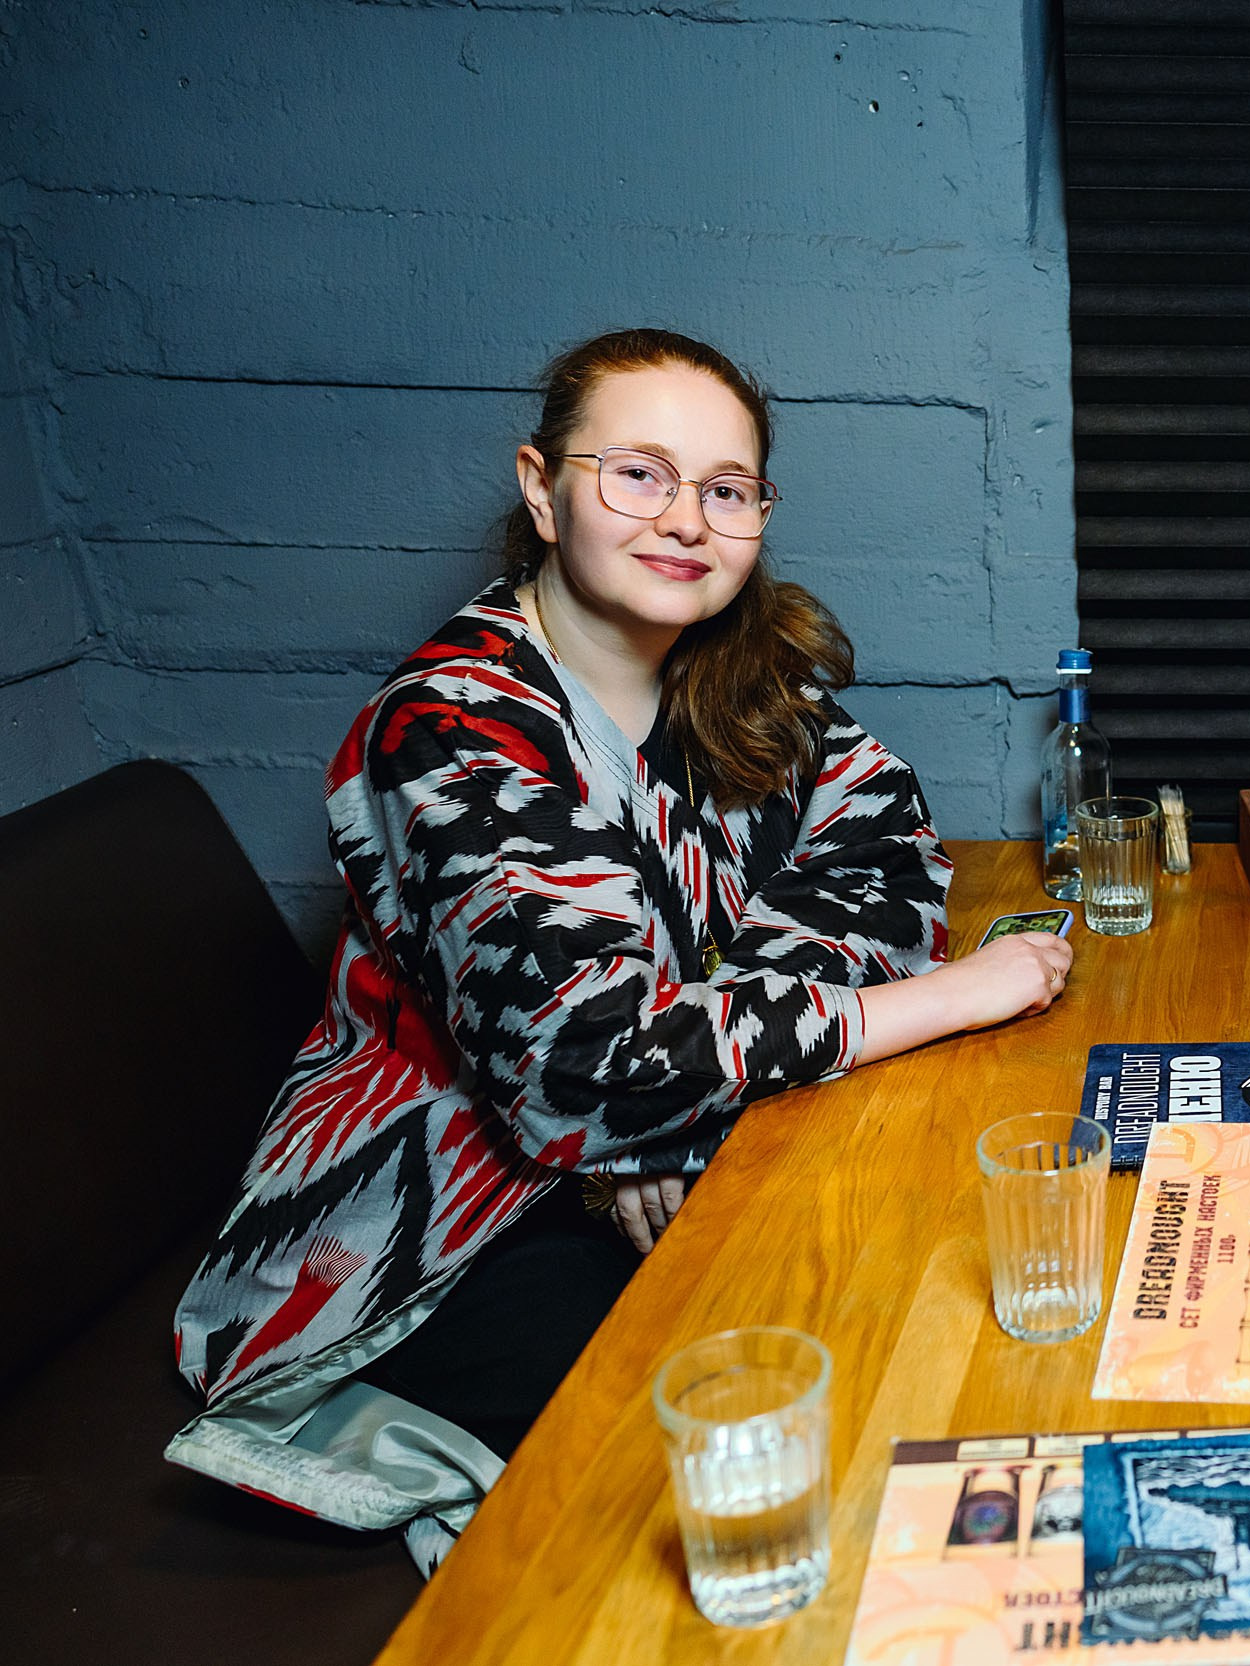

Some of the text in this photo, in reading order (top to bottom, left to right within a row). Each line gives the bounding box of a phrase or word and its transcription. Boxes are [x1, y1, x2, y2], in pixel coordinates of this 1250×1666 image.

[1094, 1076, 1113, 1120] HISTORY BAR
[1113, 1052, 1161, 1144] DREADNOUGHT
[1132, 1179, 1190, 1320] DREADNOUGHT
[1178, 1175, 1222, 1329] СЕТ ФИРМЕННЫХ НАСТОЕК
